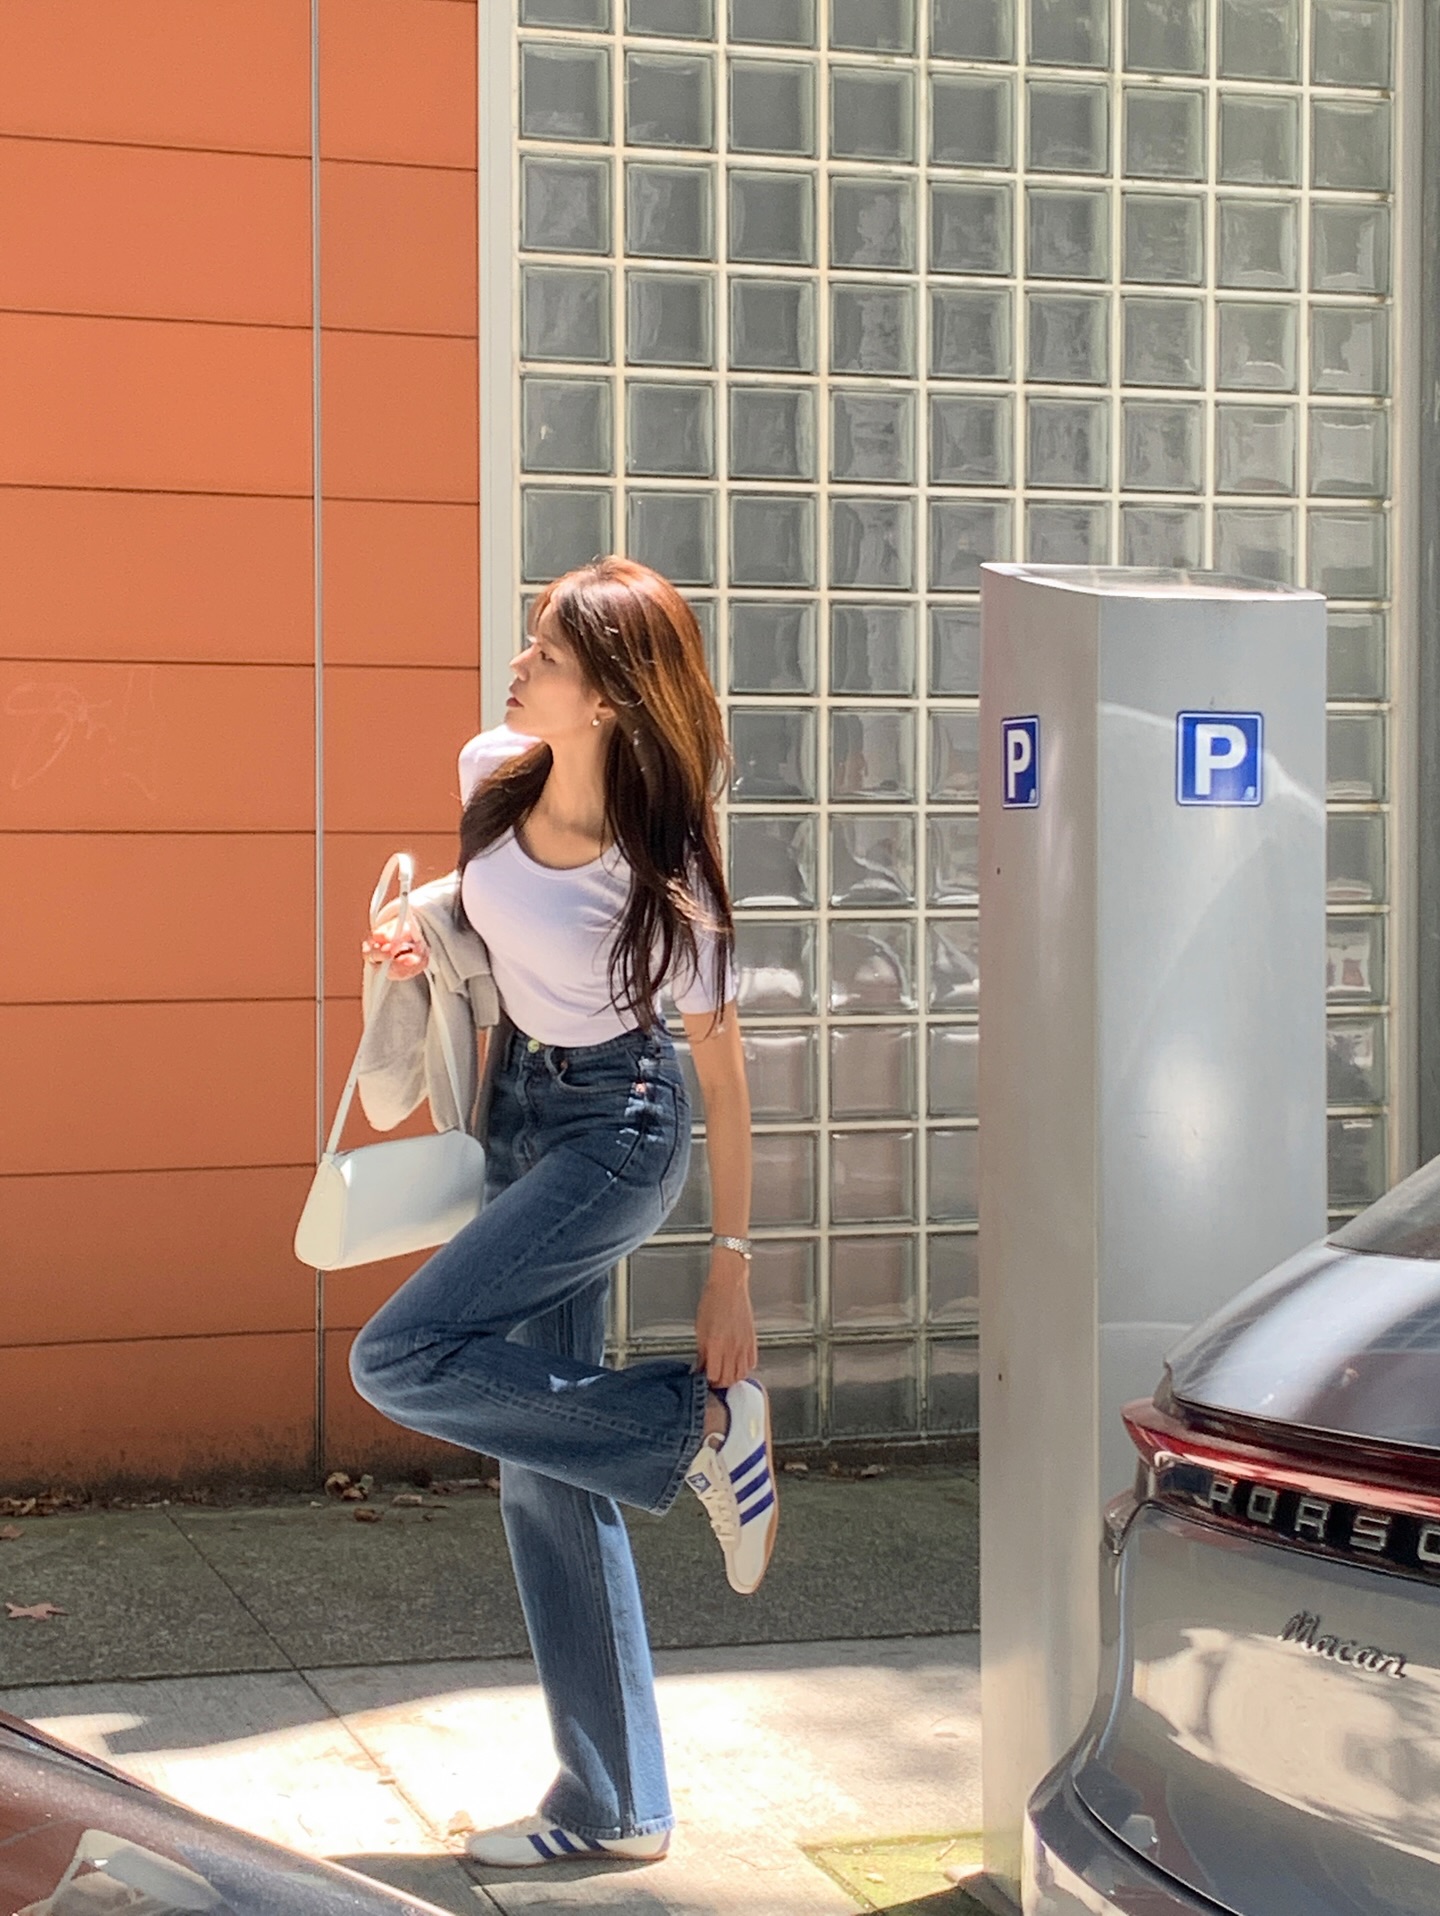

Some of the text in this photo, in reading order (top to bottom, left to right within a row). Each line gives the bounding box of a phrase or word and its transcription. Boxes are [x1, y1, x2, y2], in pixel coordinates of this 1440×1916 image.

[1006, 728, 1032, 799] P
[1194, 723, 1248, 796] P
[1277, 1610, 1407, 1679] Macan
